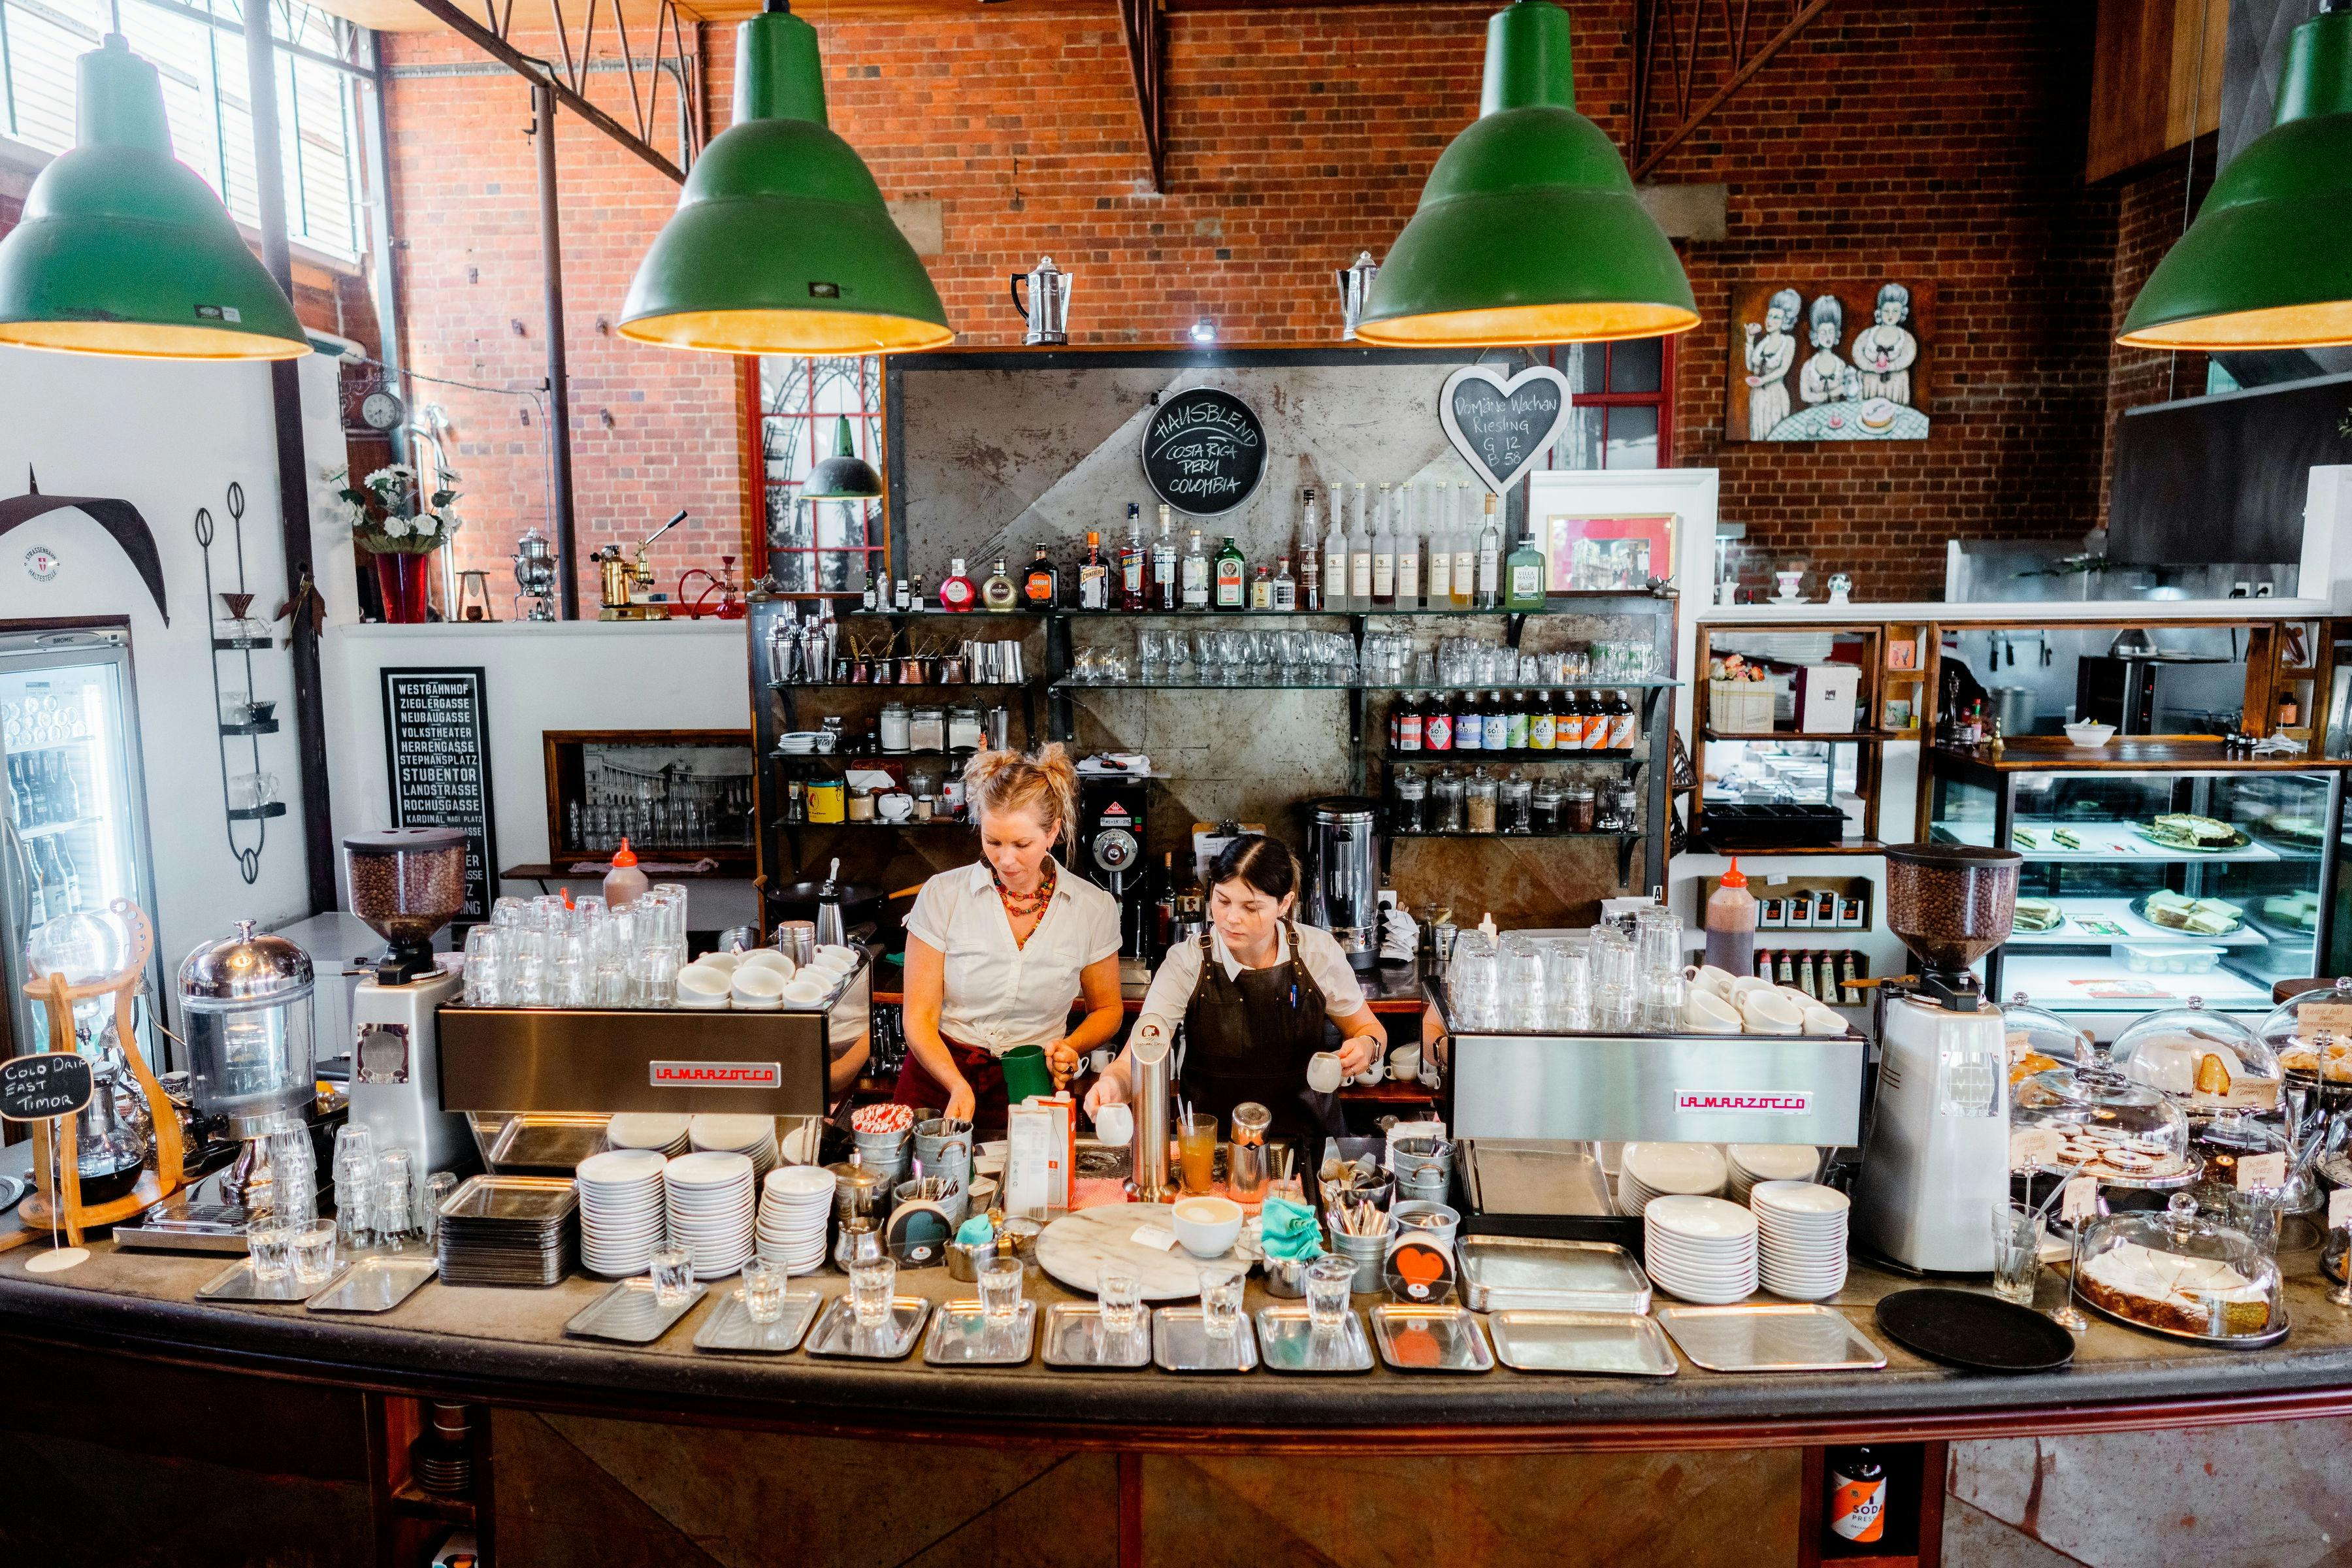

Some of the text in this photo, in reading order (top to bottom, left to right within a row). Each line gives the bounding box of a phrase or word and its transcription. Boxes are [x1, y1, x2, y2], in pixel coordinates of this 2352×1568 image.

[1155, 402, 1258, 446] HAUSBLEND
[1166, 444, 1204, 459] COSTA
[1484, 437, 1521, 453] G 12
[1488, 452, 1521, 467] B 58
[1177, 459, 1219, 475] PERU
[1169, 476, 1241, 498] COLOMBIA
[25, 547, 56, 561] STRASSENBAHN
[1122, 556, 1143, 566] APEROL
[28, 569, 57, 582] HALTESTELLE
[1083, 568, 1103, 580] COINTREAU
[399, 684, 468, 694] WESTBAHNHOF
[400, 698, 469, 709] ZIEGLERGASSE
[400, 712, 470, 723] NEUBAUGASSE
[402, 728, 472, 738] VOLKSTHEATER
[401, 741, 474, 752] HERRENGASSE
[400, 755, 478, 765] STEPHANSPLATZ
[403, 768, 476, 782] STUBENTOR
[403, 785, 478, 796] LANDSTRASSE
[404, 800, 479, 811] ROCHUSGASSE
[5, 1081, 46, 1096] EAST
[17, 1095, 73, 1111] TIMOR
